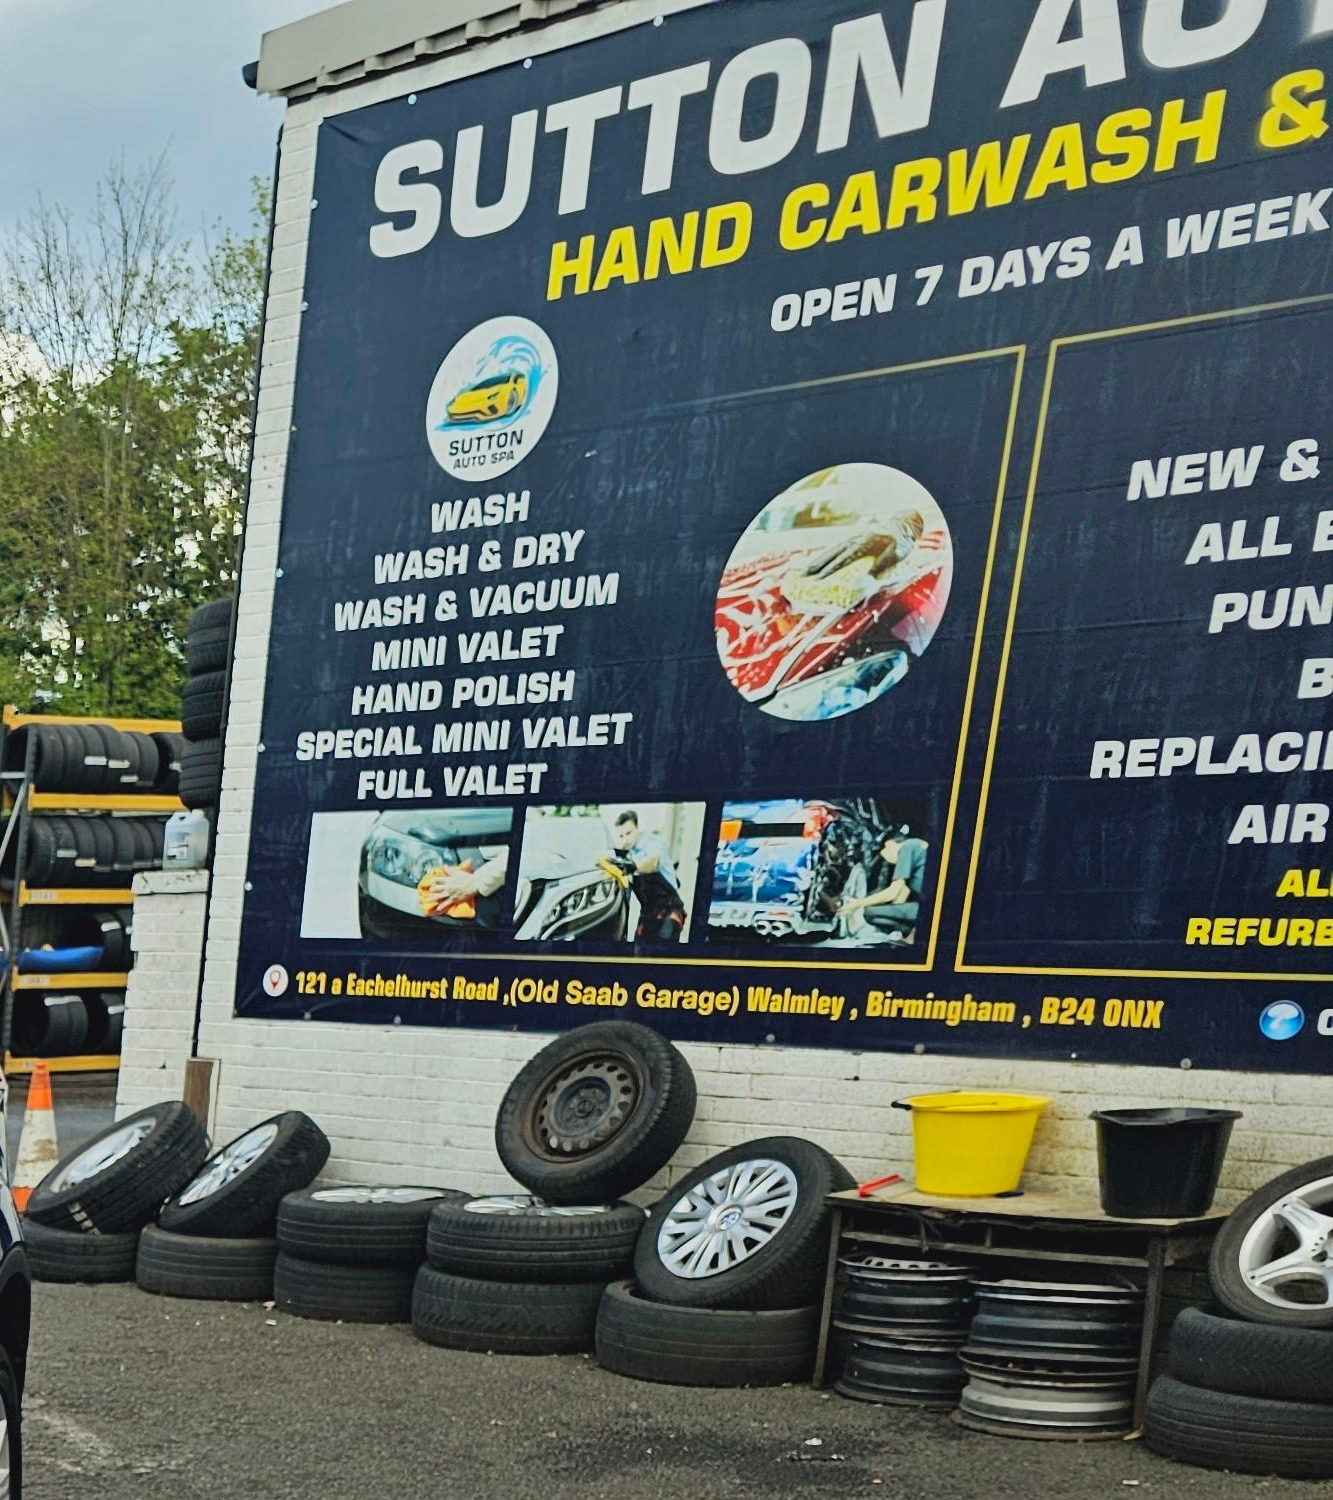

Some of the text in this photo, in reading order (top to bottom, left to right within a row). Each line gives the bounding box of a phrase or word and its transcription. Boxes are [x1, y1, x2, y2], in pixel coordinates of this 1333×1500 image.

[369, 0, 946, 258] SUTTON
[546, 68, 1330, 301] HAND CARWASH &
[770, 187, 1333, 334] OPEN 7 DAYS A WEEK
[448, 429, 524, 457] SUTTON
[453, 451, 515, 469] AUTO SPA
[1127, 438, 1320, 501] NEW &
[431, 490, 530, 534] WASH
[374, 529, 585, 584] WASH & DRY
[1185, 516, 1292, 565] ALL
[334, 572, 620, 632] WASH & VACUUM
[371, 624, 564, 671] MINI VALET
[351, 670, 576, 715] HAND POLISH
[296, 712, 633, 761] SPECIAL MINI VALET
[357, 762, 548, 800] FULL VALET
[1227, 803, 1329, 844] AIR
[295, 971, 326, 994] 121
[332, 977, 341, 994] a
[346, 973, 448, 999] Eachelhurst
[453, 976, 499, 1001] Road
[565, 980, 628, 1007] Saab
[636, 982, 740, 1015] Garage)
[746, 987, 842, 1021] Walmley
[865, 991, 1016, 1027] Birmingham
[1040, 997, 1095, 1027] B24
